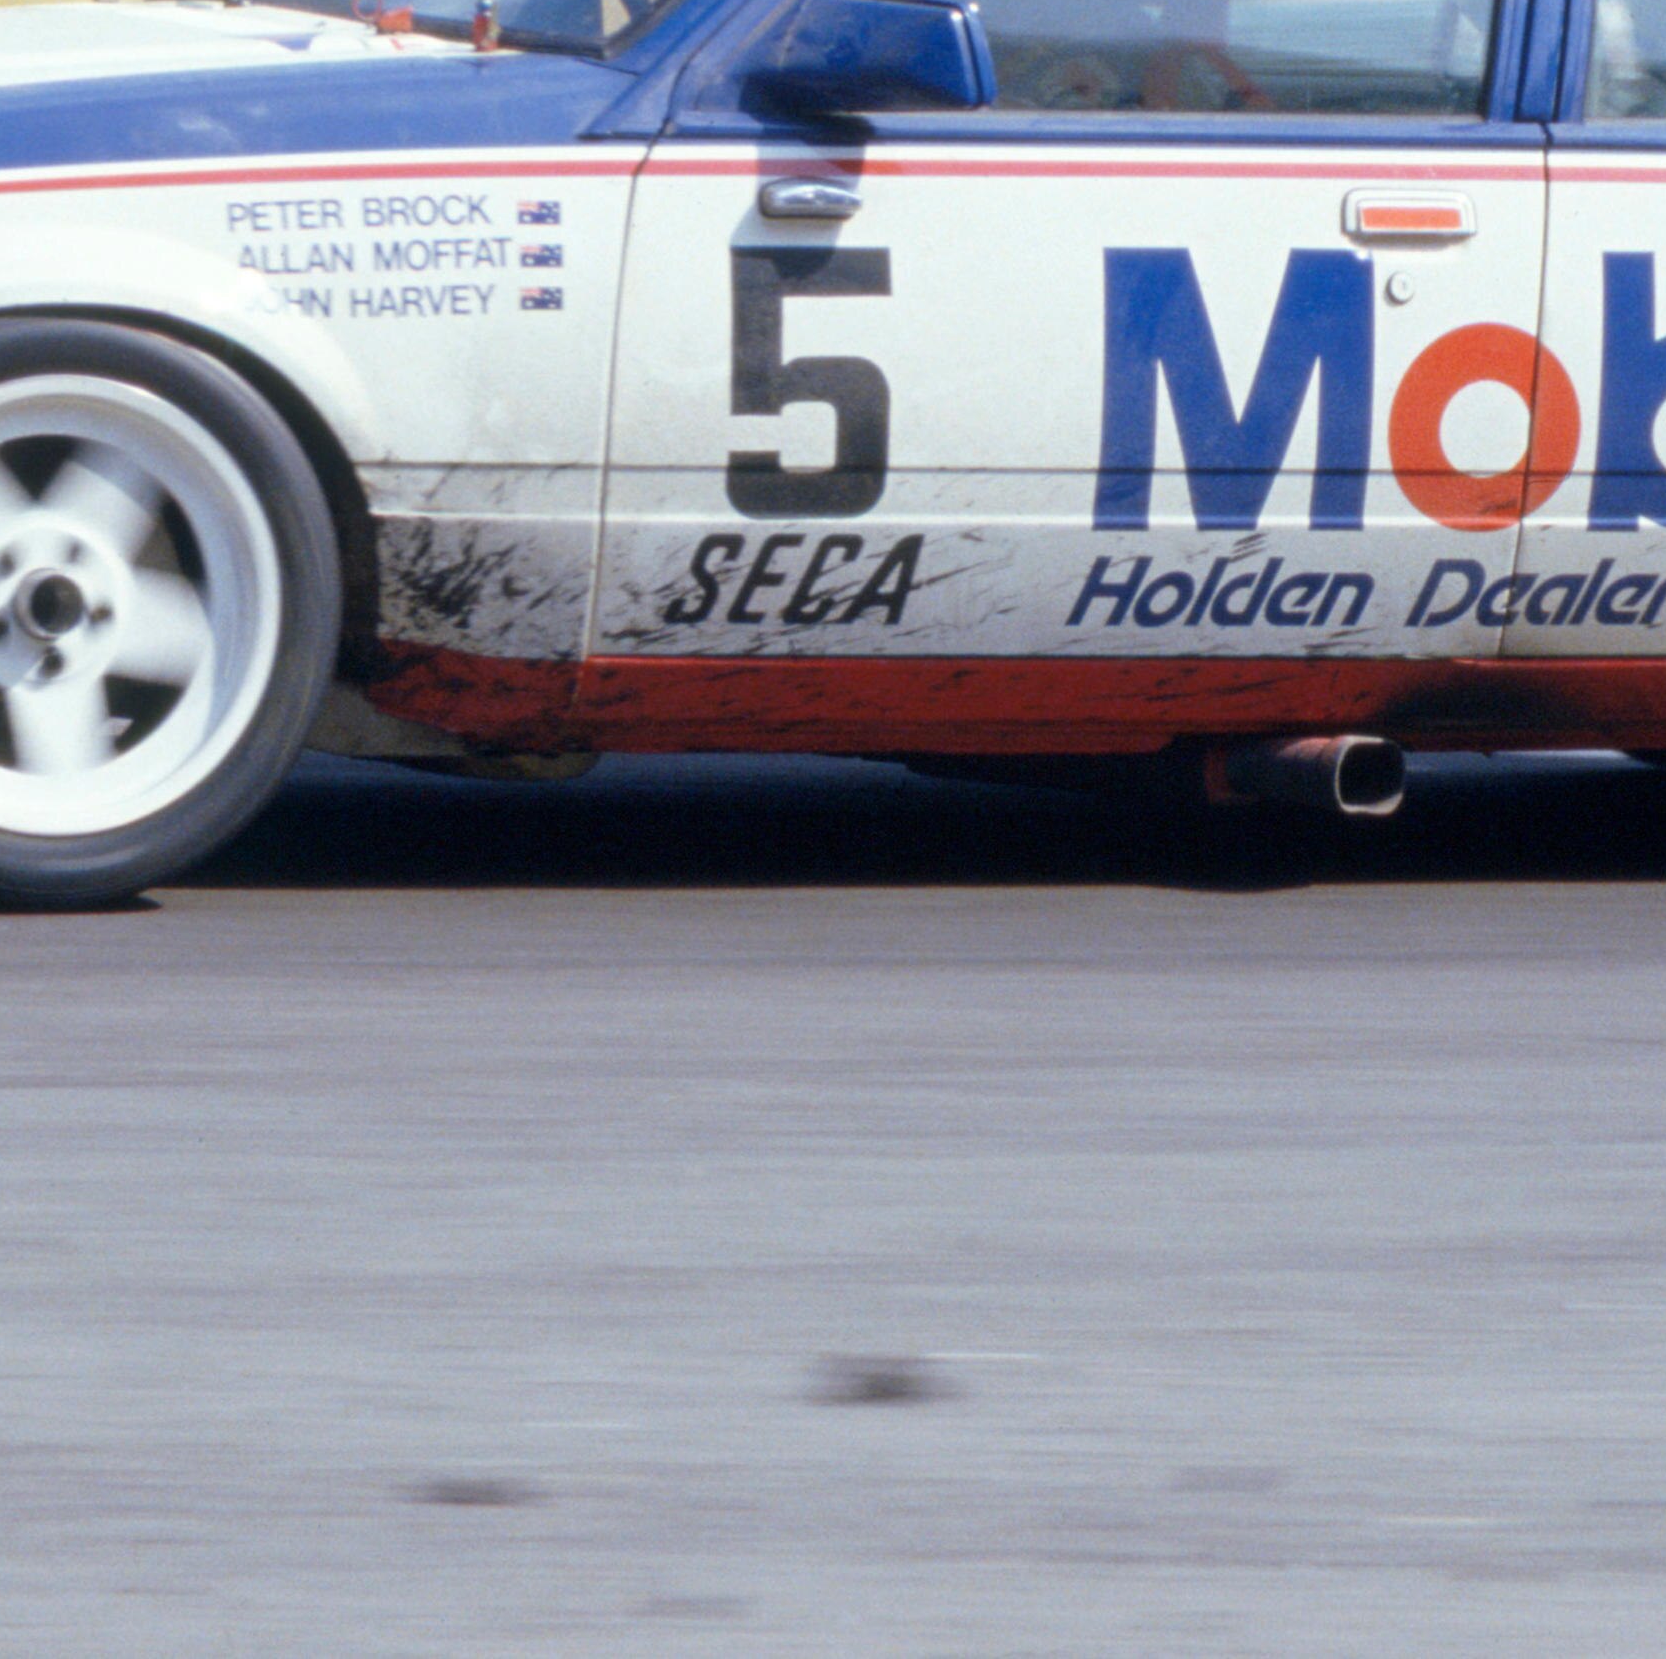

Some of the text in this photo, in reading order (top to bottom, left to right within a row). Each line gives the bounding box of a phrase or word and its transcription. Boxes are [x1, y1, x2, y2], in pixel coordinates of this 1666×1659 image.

[226, 195, 492, 231] PETER BROCK
[238, 237, 513, 274] ALLAN MOFFAT
[350, 284, 495, 318] HARVEY
[725, 246, 893, 519] 5
[662, 533, 925, 625] SECA
[1065, 556, 1373, 627] Holden
